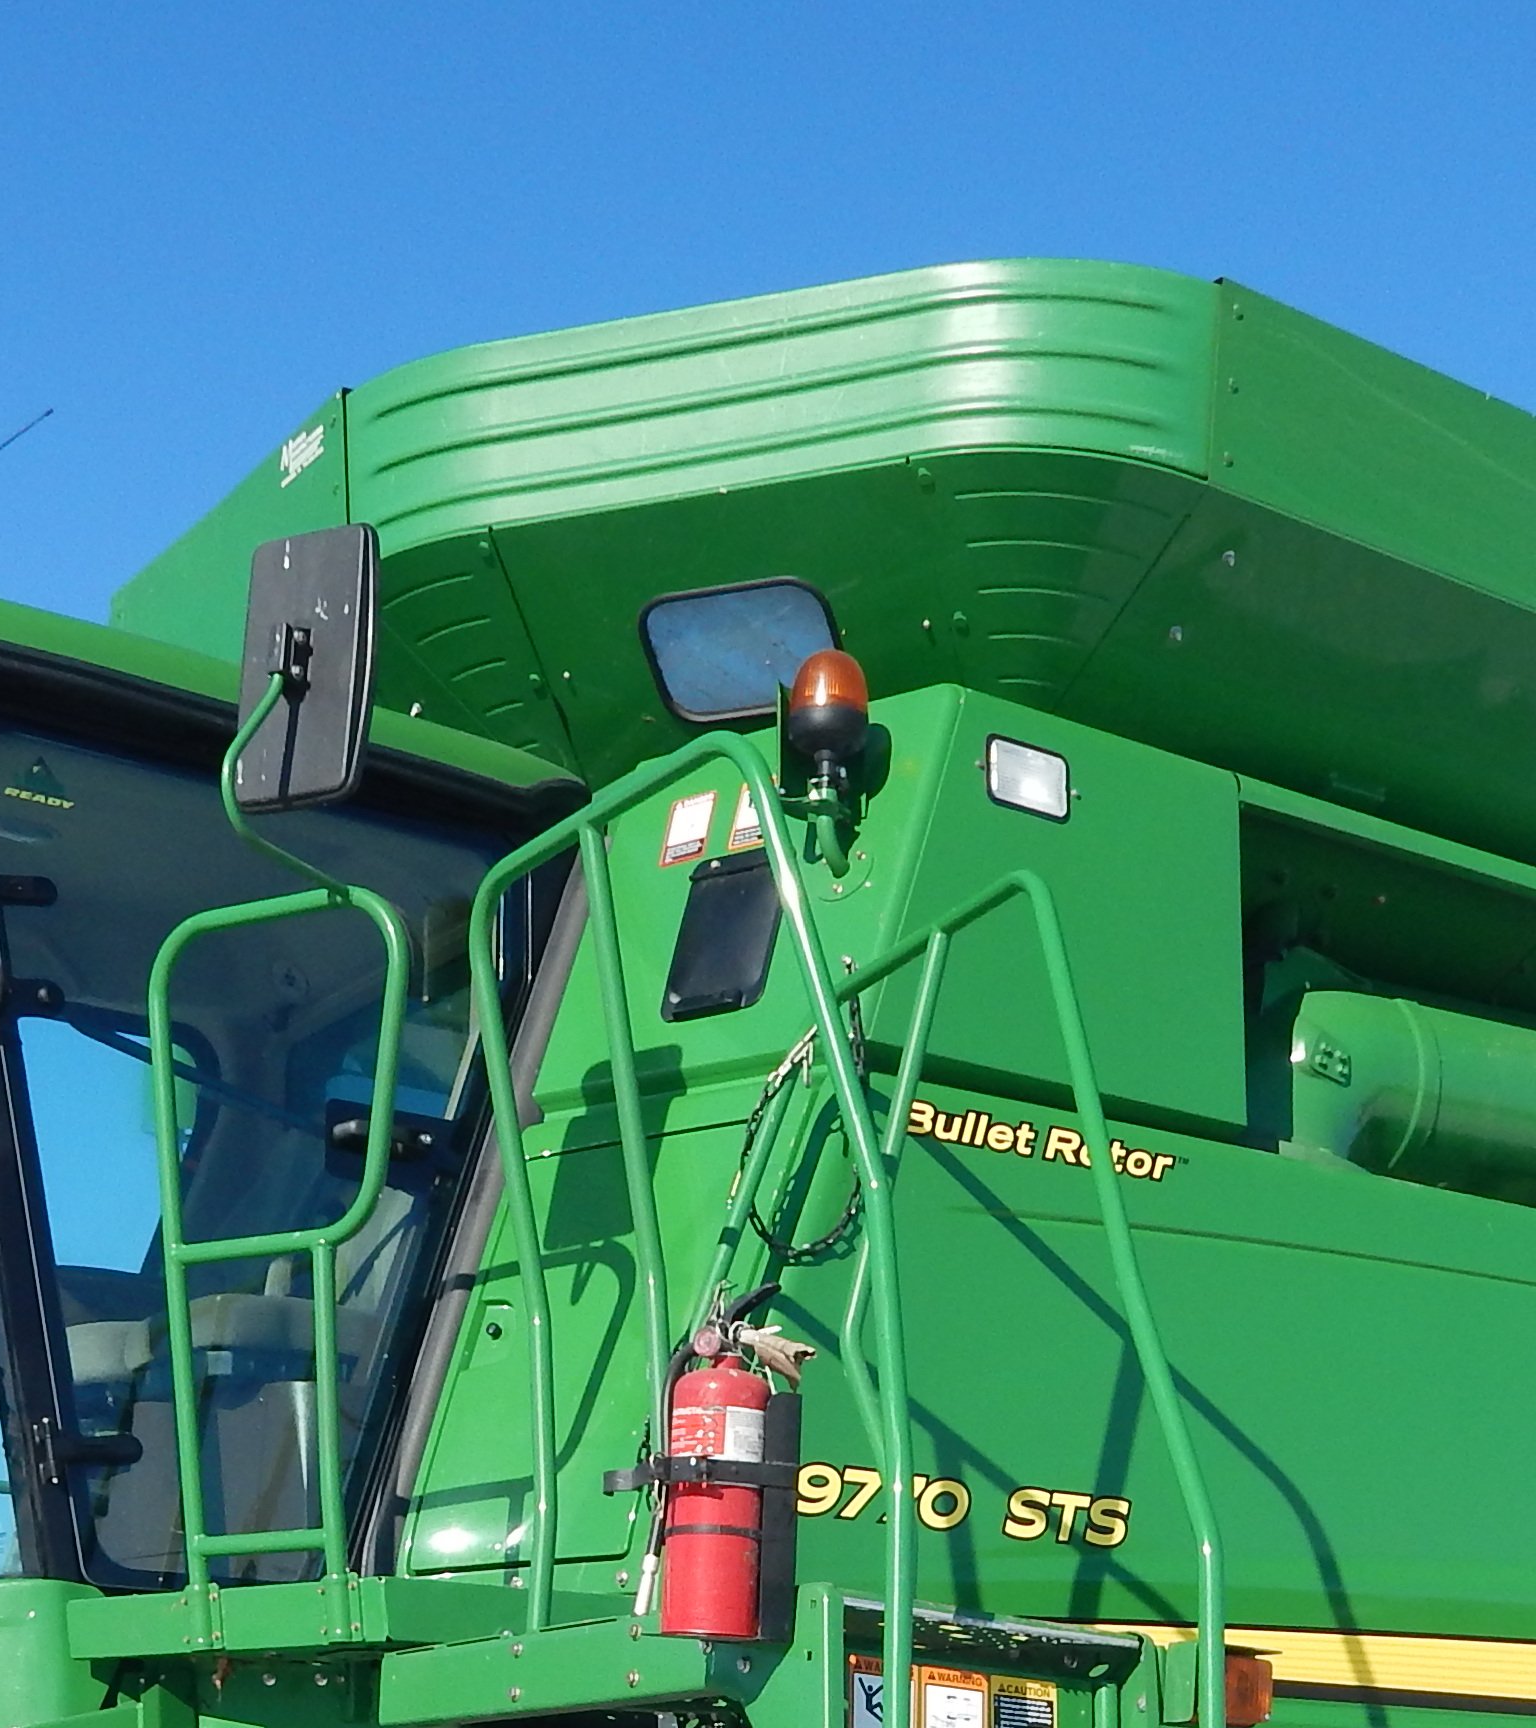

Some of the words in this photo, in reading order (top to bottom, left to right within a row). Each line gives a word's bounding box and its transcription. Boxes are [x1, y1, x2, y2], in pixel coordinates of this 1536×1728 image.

[4, 787, 75, 809] READY
[906, 1098, 1038, 1157] Bullet
[1002, 1485, 1133, 1550] STS
[937, 1671, 983, 1687] WARNING
[1006, 1684, 1051, 1699] CAUTION
